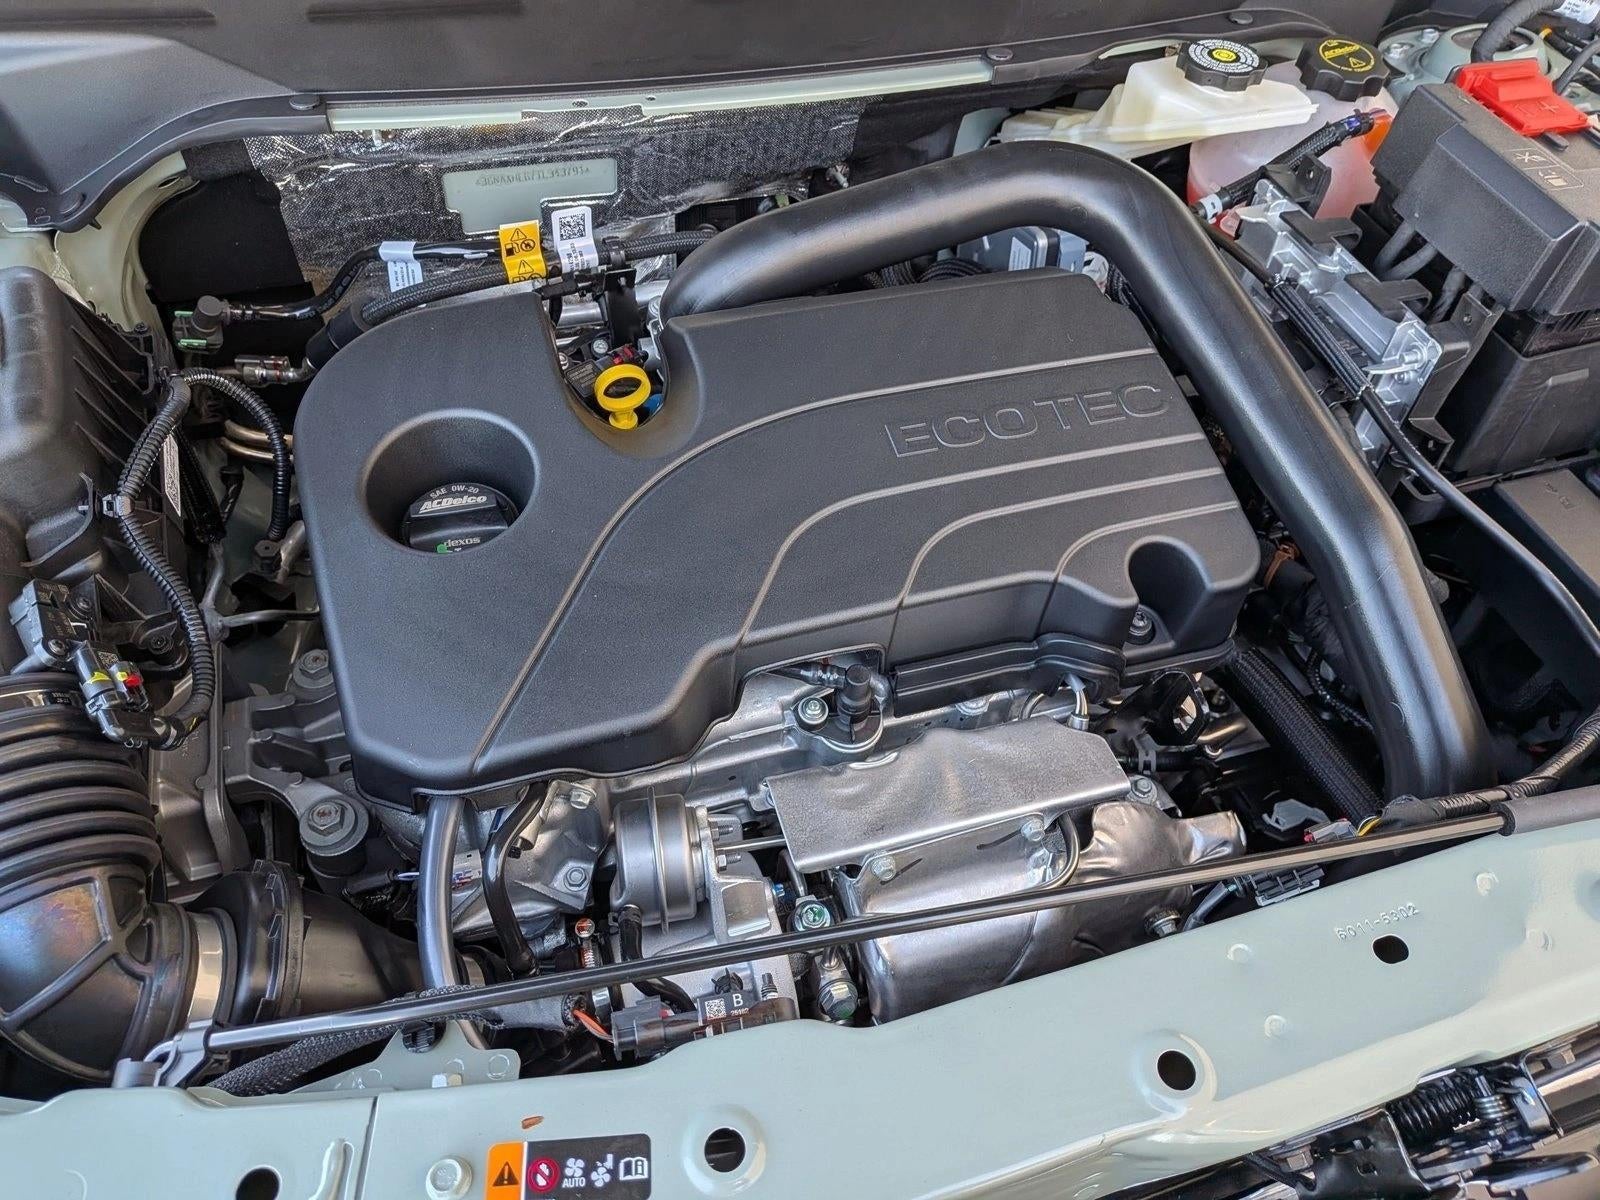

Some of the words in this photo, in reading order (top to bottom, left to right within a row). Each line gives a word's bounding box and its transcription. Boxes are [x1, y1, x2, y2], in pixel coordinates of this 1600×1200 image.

[885, 385, 1169, 458] ECOTEC
[430, 488, 447, 499] SAE
[451, 485, 479, 494] 0W-20
[419, 495, 488, 513] ACDelco
[444, 537, 480, 547] dexos
[733, 993, 743, 1007] B
[562, 1177, 586, 1188] AUTO
